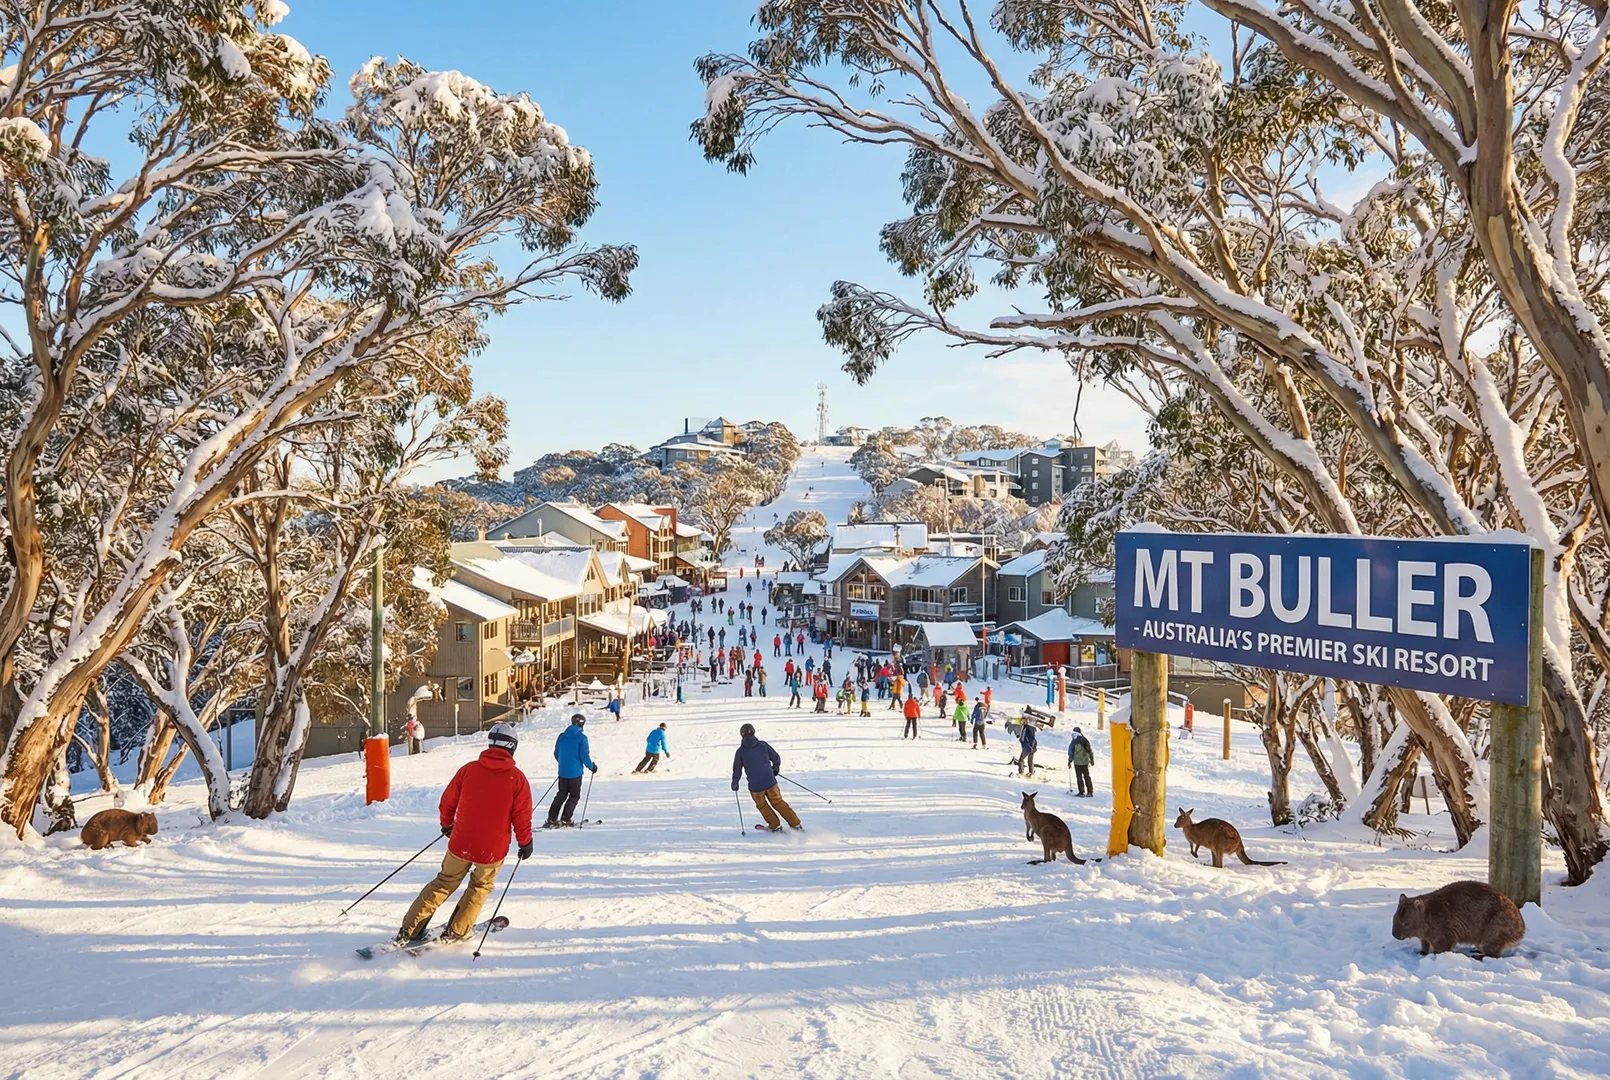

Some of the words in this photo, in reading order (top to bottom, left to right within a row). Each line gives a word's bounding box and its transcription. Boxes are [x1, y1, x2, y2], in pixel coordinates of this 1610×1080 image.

[1133, 548, 1214, 614] MT
[1229, 552, 1495, 644] BULLER
[1142, 619, 1253, 651] AUSTRALIA'S
[1257, 632, 1348, 664] PREMIER
[1352, 643, 1388, 669] SKI
[1394, 647, 1495, 682] RESORT
